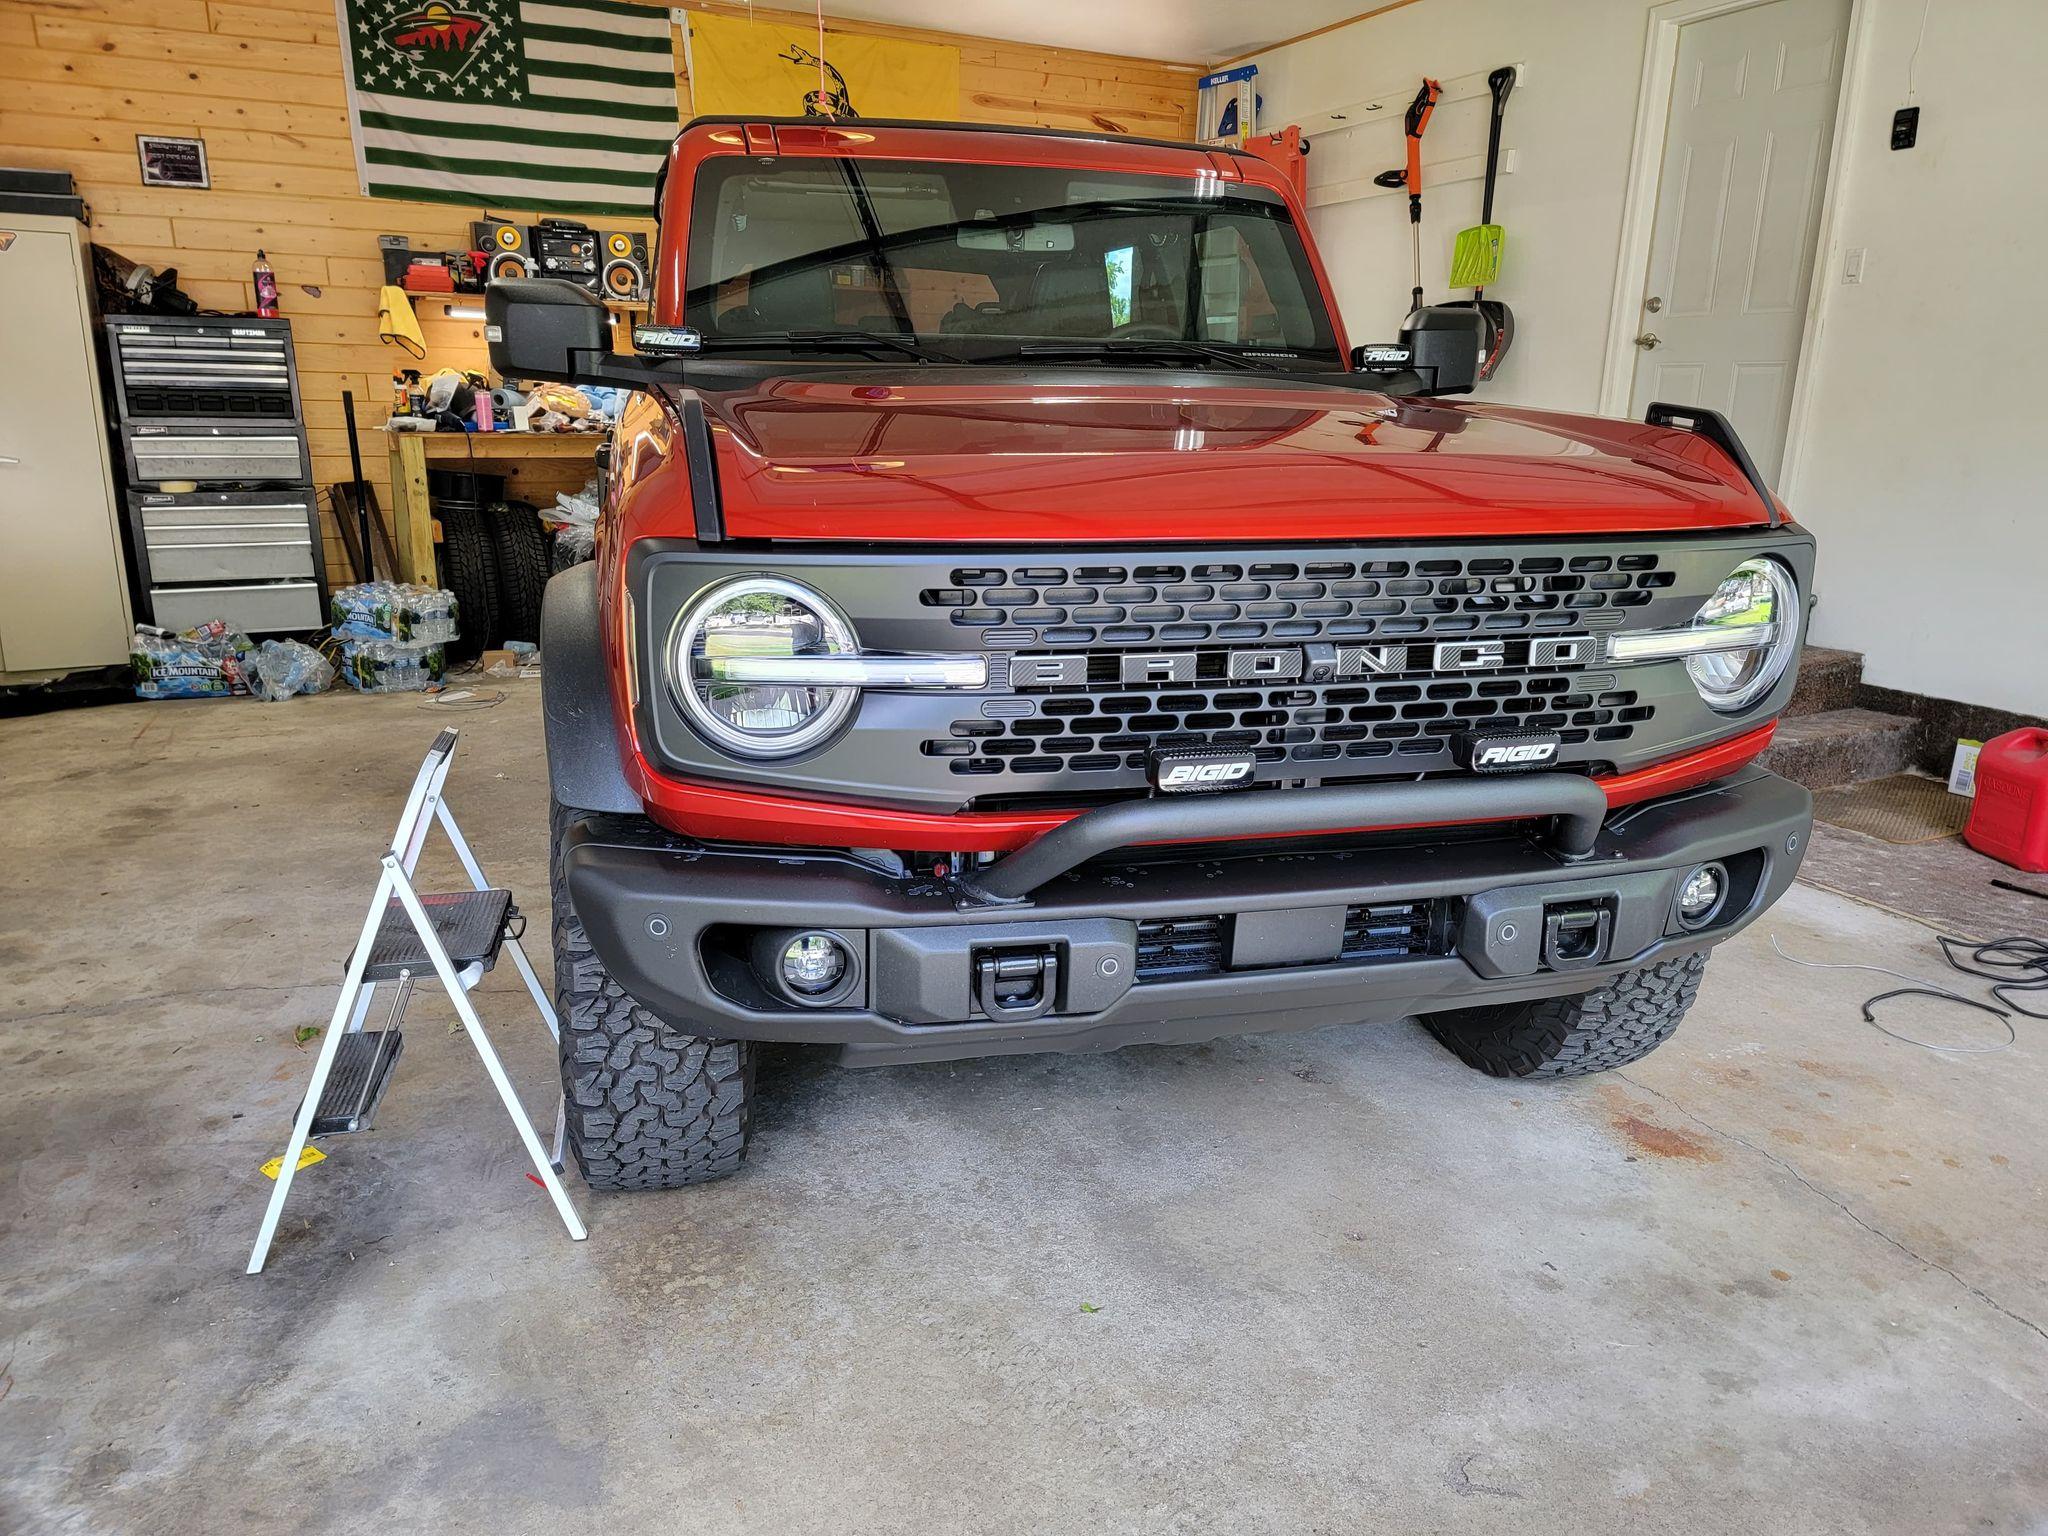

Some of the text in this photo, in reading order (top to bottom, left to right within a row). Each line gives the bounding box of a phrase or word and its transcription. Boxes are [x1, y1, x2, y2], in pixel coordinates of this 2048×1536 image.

[1210, 75, 1229, 85] KELLER
[640, 331, 696, 345] RIGID
[1367, 350, 1410, 361] RIGID
[1009, 636, 1597, 687] BRONCO
[152, 667, 168, 677] ICE
[168, 667, 218, 677] MOUNTAIN
[1479, 743, 1557, 764] RIGID
[1166, 763, 1251, 782] RIGID
